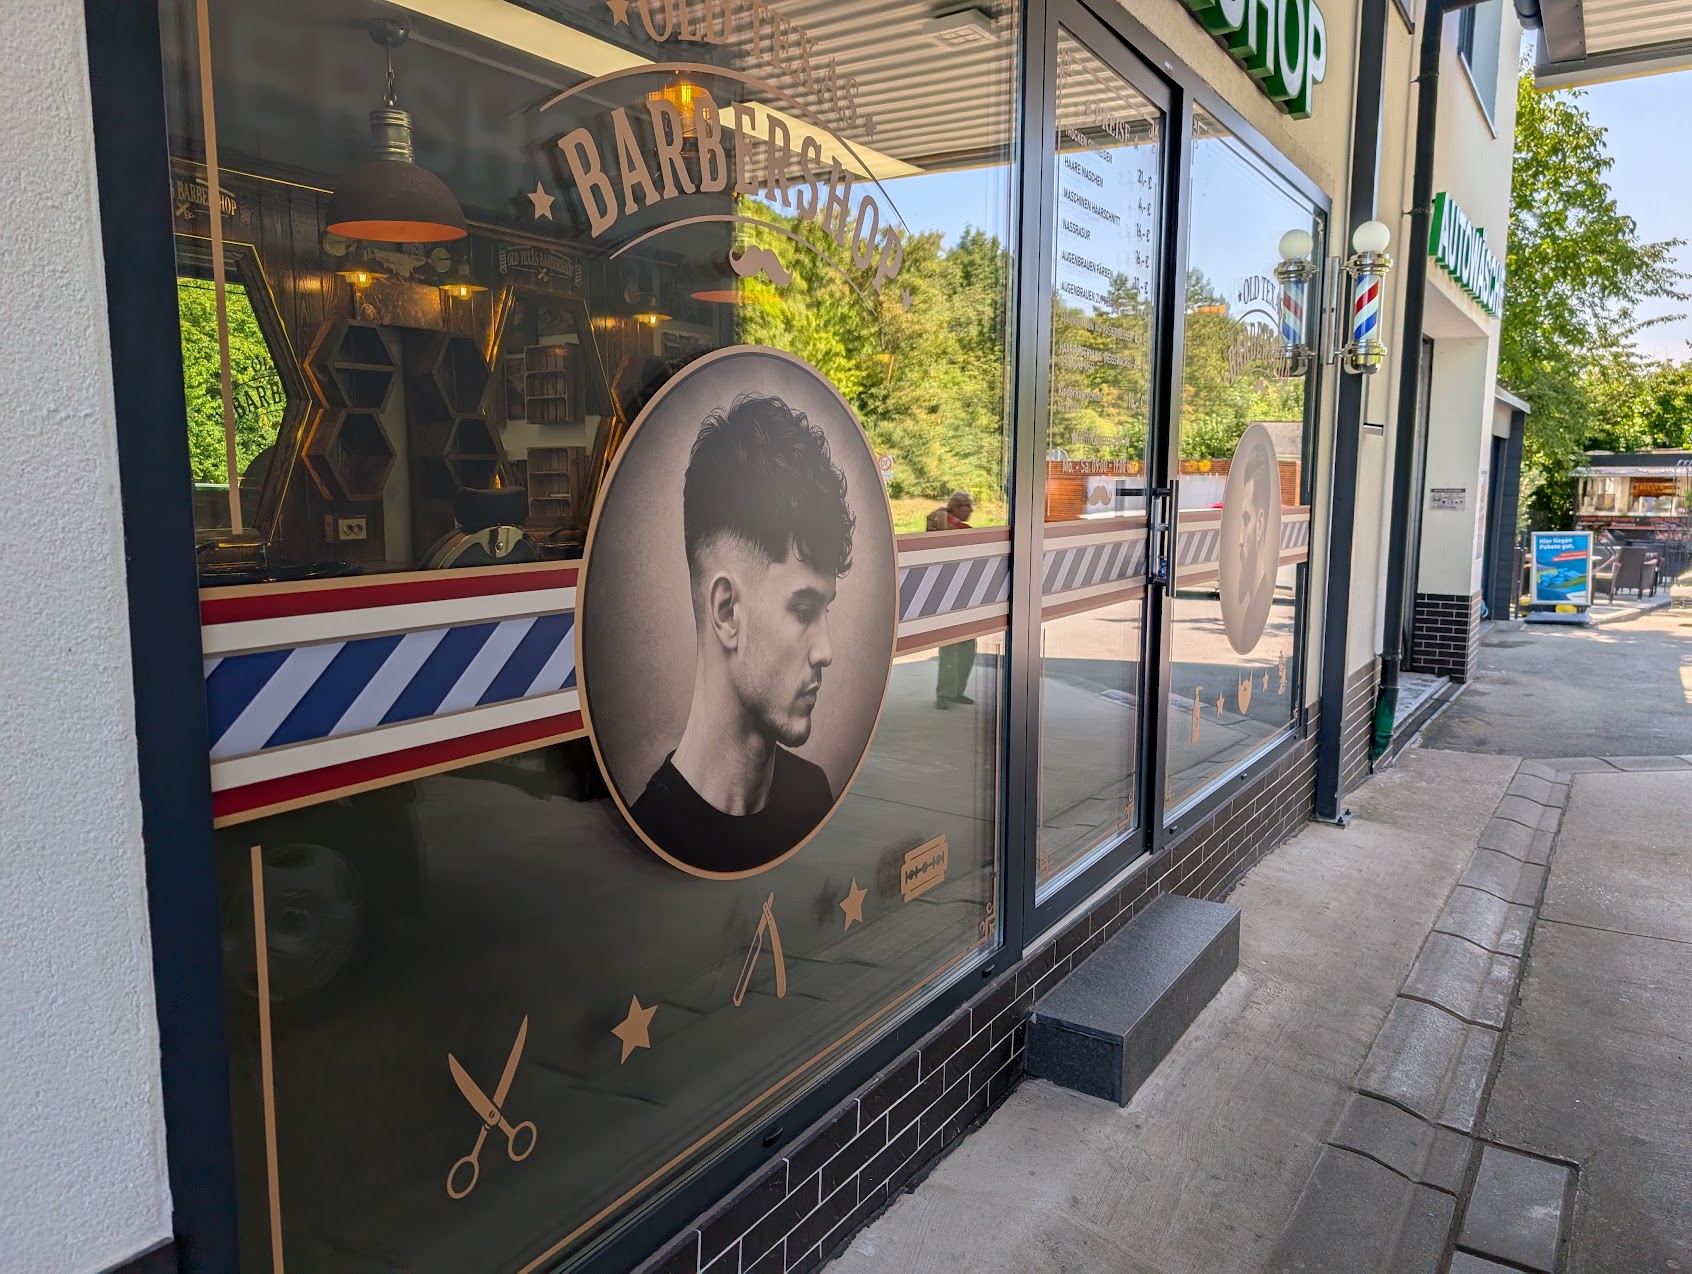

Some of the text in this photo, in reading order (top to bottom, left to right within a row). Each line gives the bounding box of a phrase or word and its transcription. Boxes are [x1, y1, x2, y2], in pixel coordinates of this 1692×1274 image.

[750, 0, 860, 128] TEXAS
[1095, 102, 1131, 144] PREISE
[1065, 125, 1088, 148] TROCKEN
[1064, 156, 1081, 175] HAARE
[176, 181, 237, 216] BARBEHOP
[557, 95, 903, 294] BARBERSHOP
[1063, 186, 1092, 212] MASCHINEN
[1062, 218, 1091, 241] NASSRASUR
[507, 251, 519, 266] OLD
[520, 249, 539, 266] TEXAS
[1061, 249, 1097, 274] AUGENBRAUEN
[1060, 280, 1096, 301] AUGENBRAUEN
[1243, 275, 1260, 305] OLD
[1062, 460, 1074, 473] Mo.
[1080, 460, 1089, 473] Sa.
[1552, 537, 1573, 545] liegen
